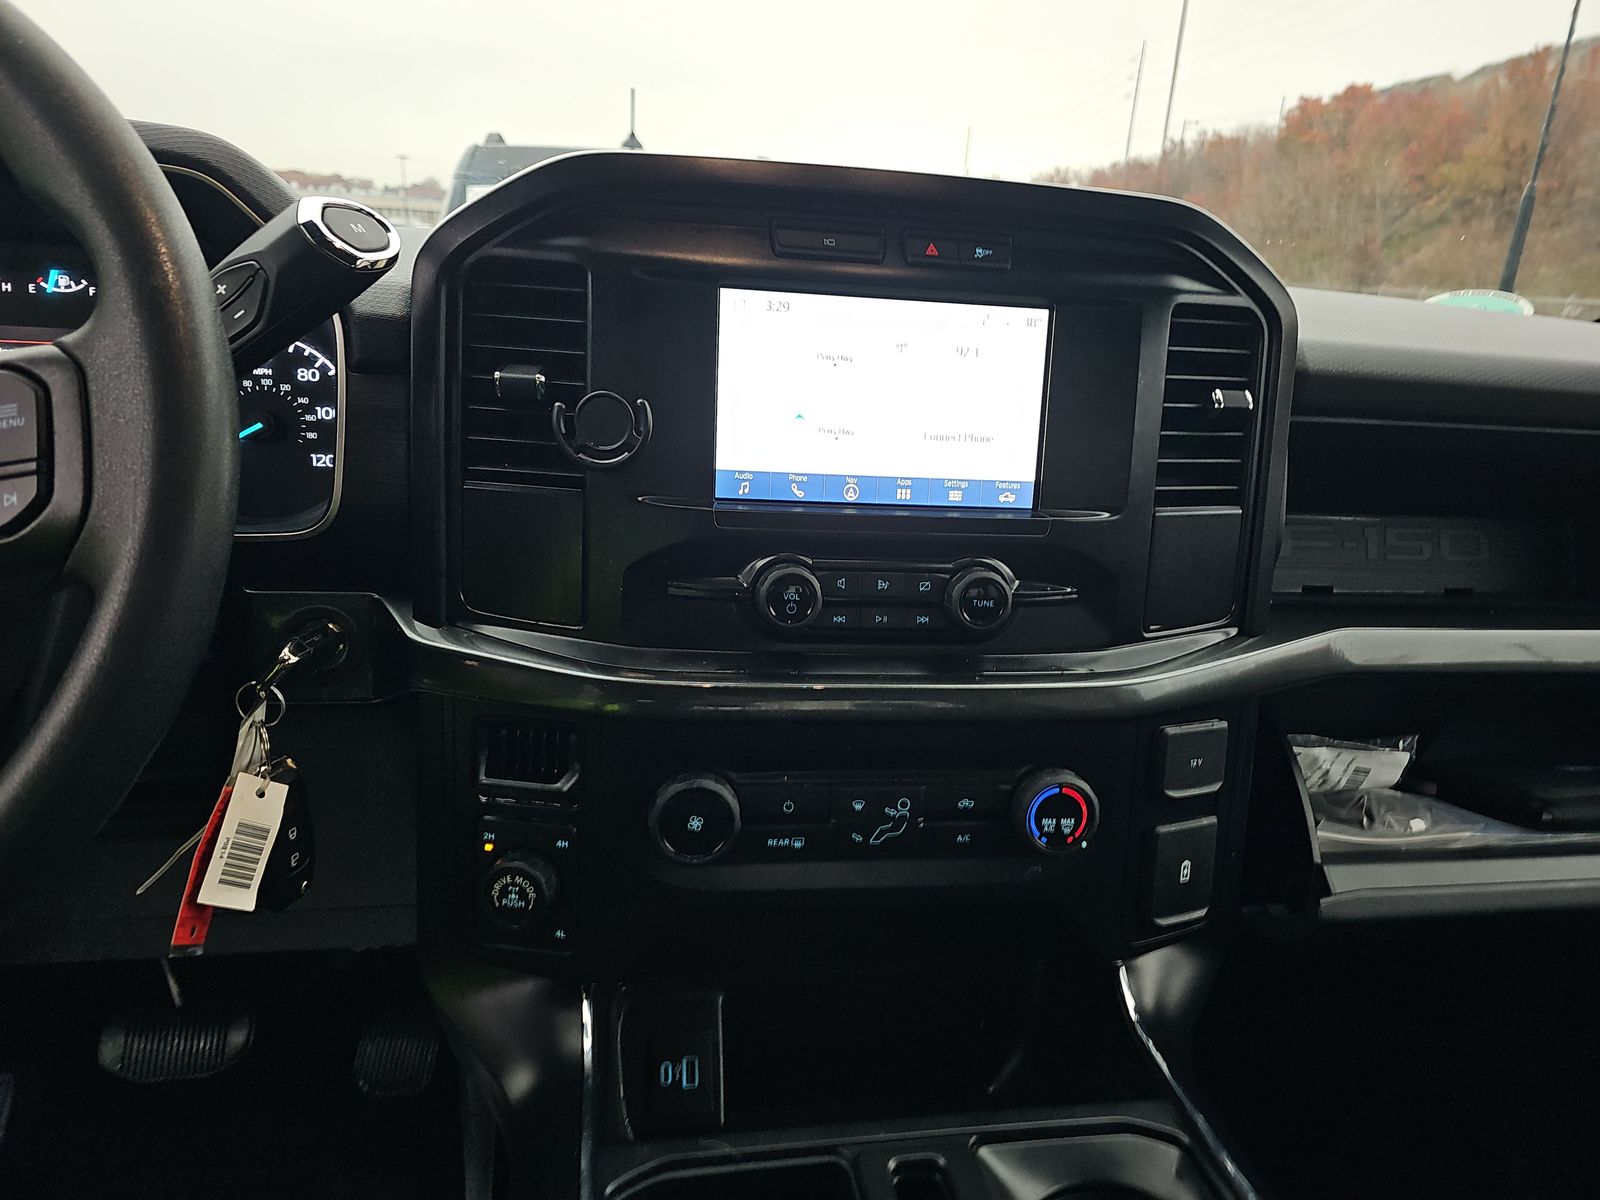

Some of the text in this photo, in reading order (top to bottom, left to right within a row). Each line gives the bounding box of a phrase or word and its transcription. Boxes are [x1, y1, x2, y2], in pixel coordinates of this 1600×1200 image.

[350, 223, 366, 233] M
[1, 282, 12, 292] H
[28, 284, 36, 293] E
[88, 286, 97, 296] F
[765, 300, 790, 312] 3:29
[297, 368, 320, 382] 80
[260, 378, 273, 386] 100
[280, 383, 291, 391] 120
[0, 416, 25, 430] ENU
[734, 471, 754, 480] Audio
[788, 473, 808, 482] Phone
[845, 476, 858, 484] Nav
[896, 478, 913, 486] Apps
[943, 479, 969, 489] Settings
[994, 481, 1021, 490] Features
[1280, 524, 1490, 563] F-150
[783, 592, 801, 601] VOL
[972, 599, 995, 608] TUNE
[1041, 817, 1057, 826] MAX
[483, 832, 495, 841] 2H
[956, 834, 972, 843] A/C
[556, 840, 569, 849] 4H
[767, 838, 790, 847] REAR
[491, 874, 537, 900] DRIVE MODE
[501, 898, 526, 908] PUSH
